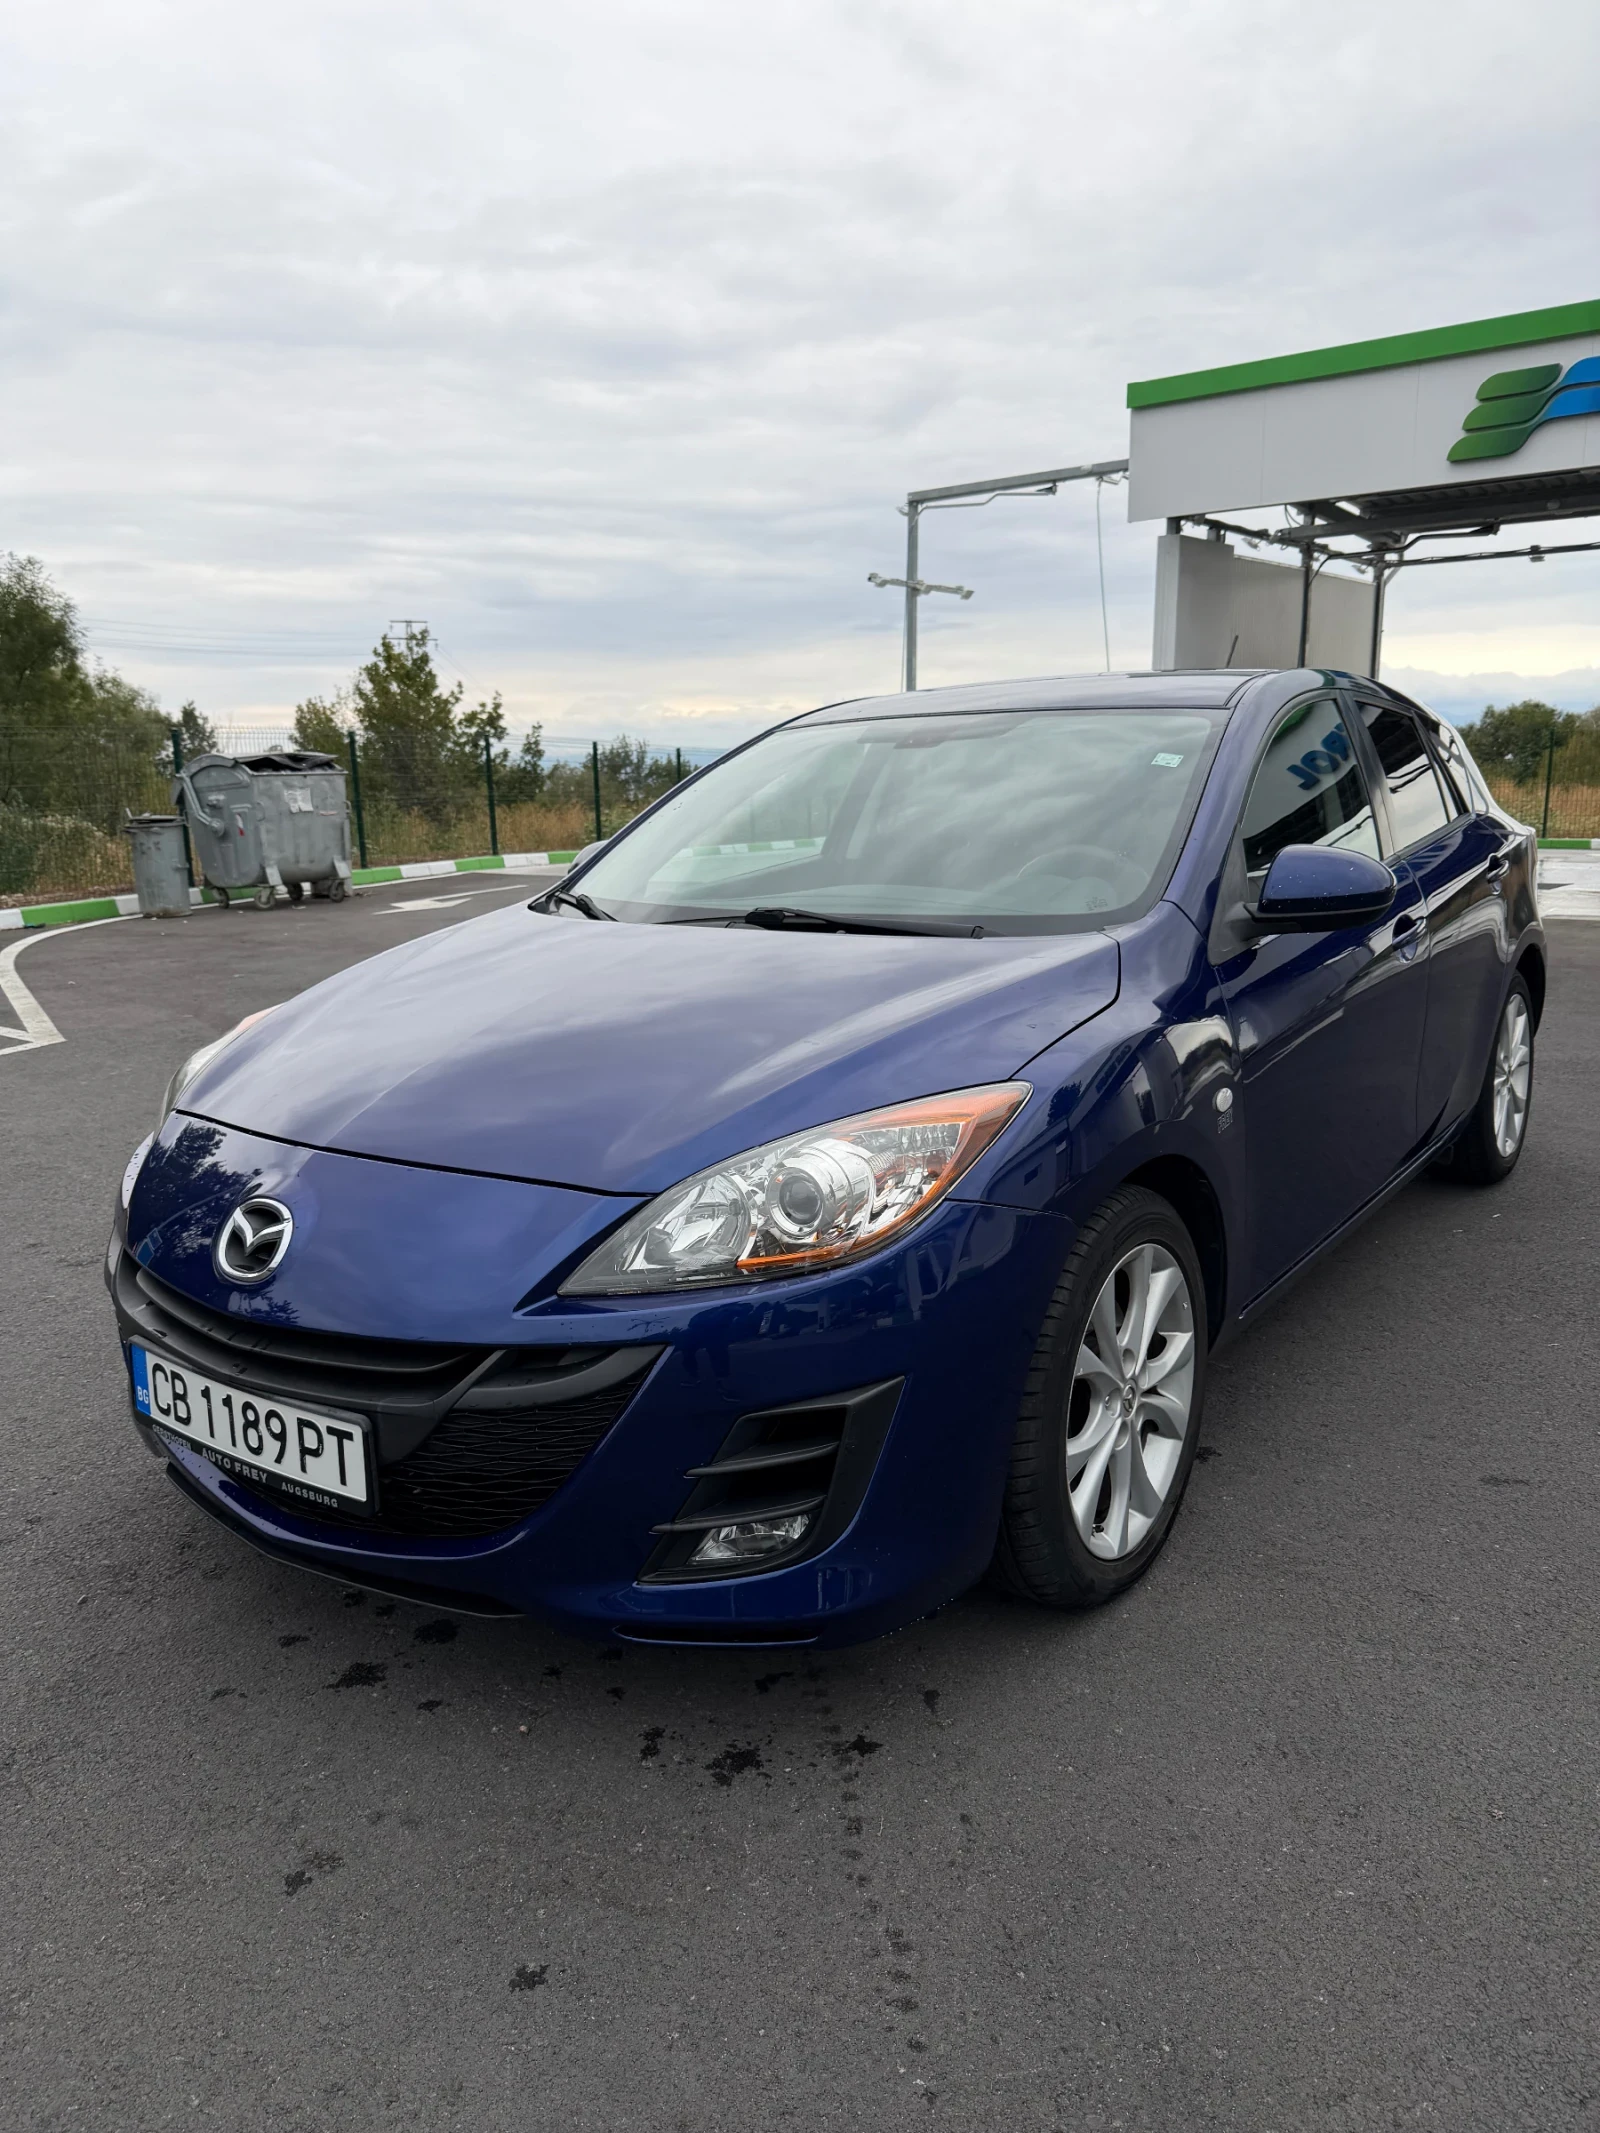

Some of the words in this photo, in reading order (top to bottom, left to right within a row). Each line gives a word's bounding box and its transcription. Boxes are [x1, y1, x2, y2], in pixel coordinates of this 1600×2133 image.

[136, 1385, 150, 1405] BG
[151, 1362, 191, 1426] CB
[200, 1384, 288, 1465] 1189
[296, 1416, 354, 1487] PT
[201, 1447, 232, 1470] AUTO
[234, 1461, 268, 1484] FREY
[281, 1481, 339, 1508] AUGSBURG
